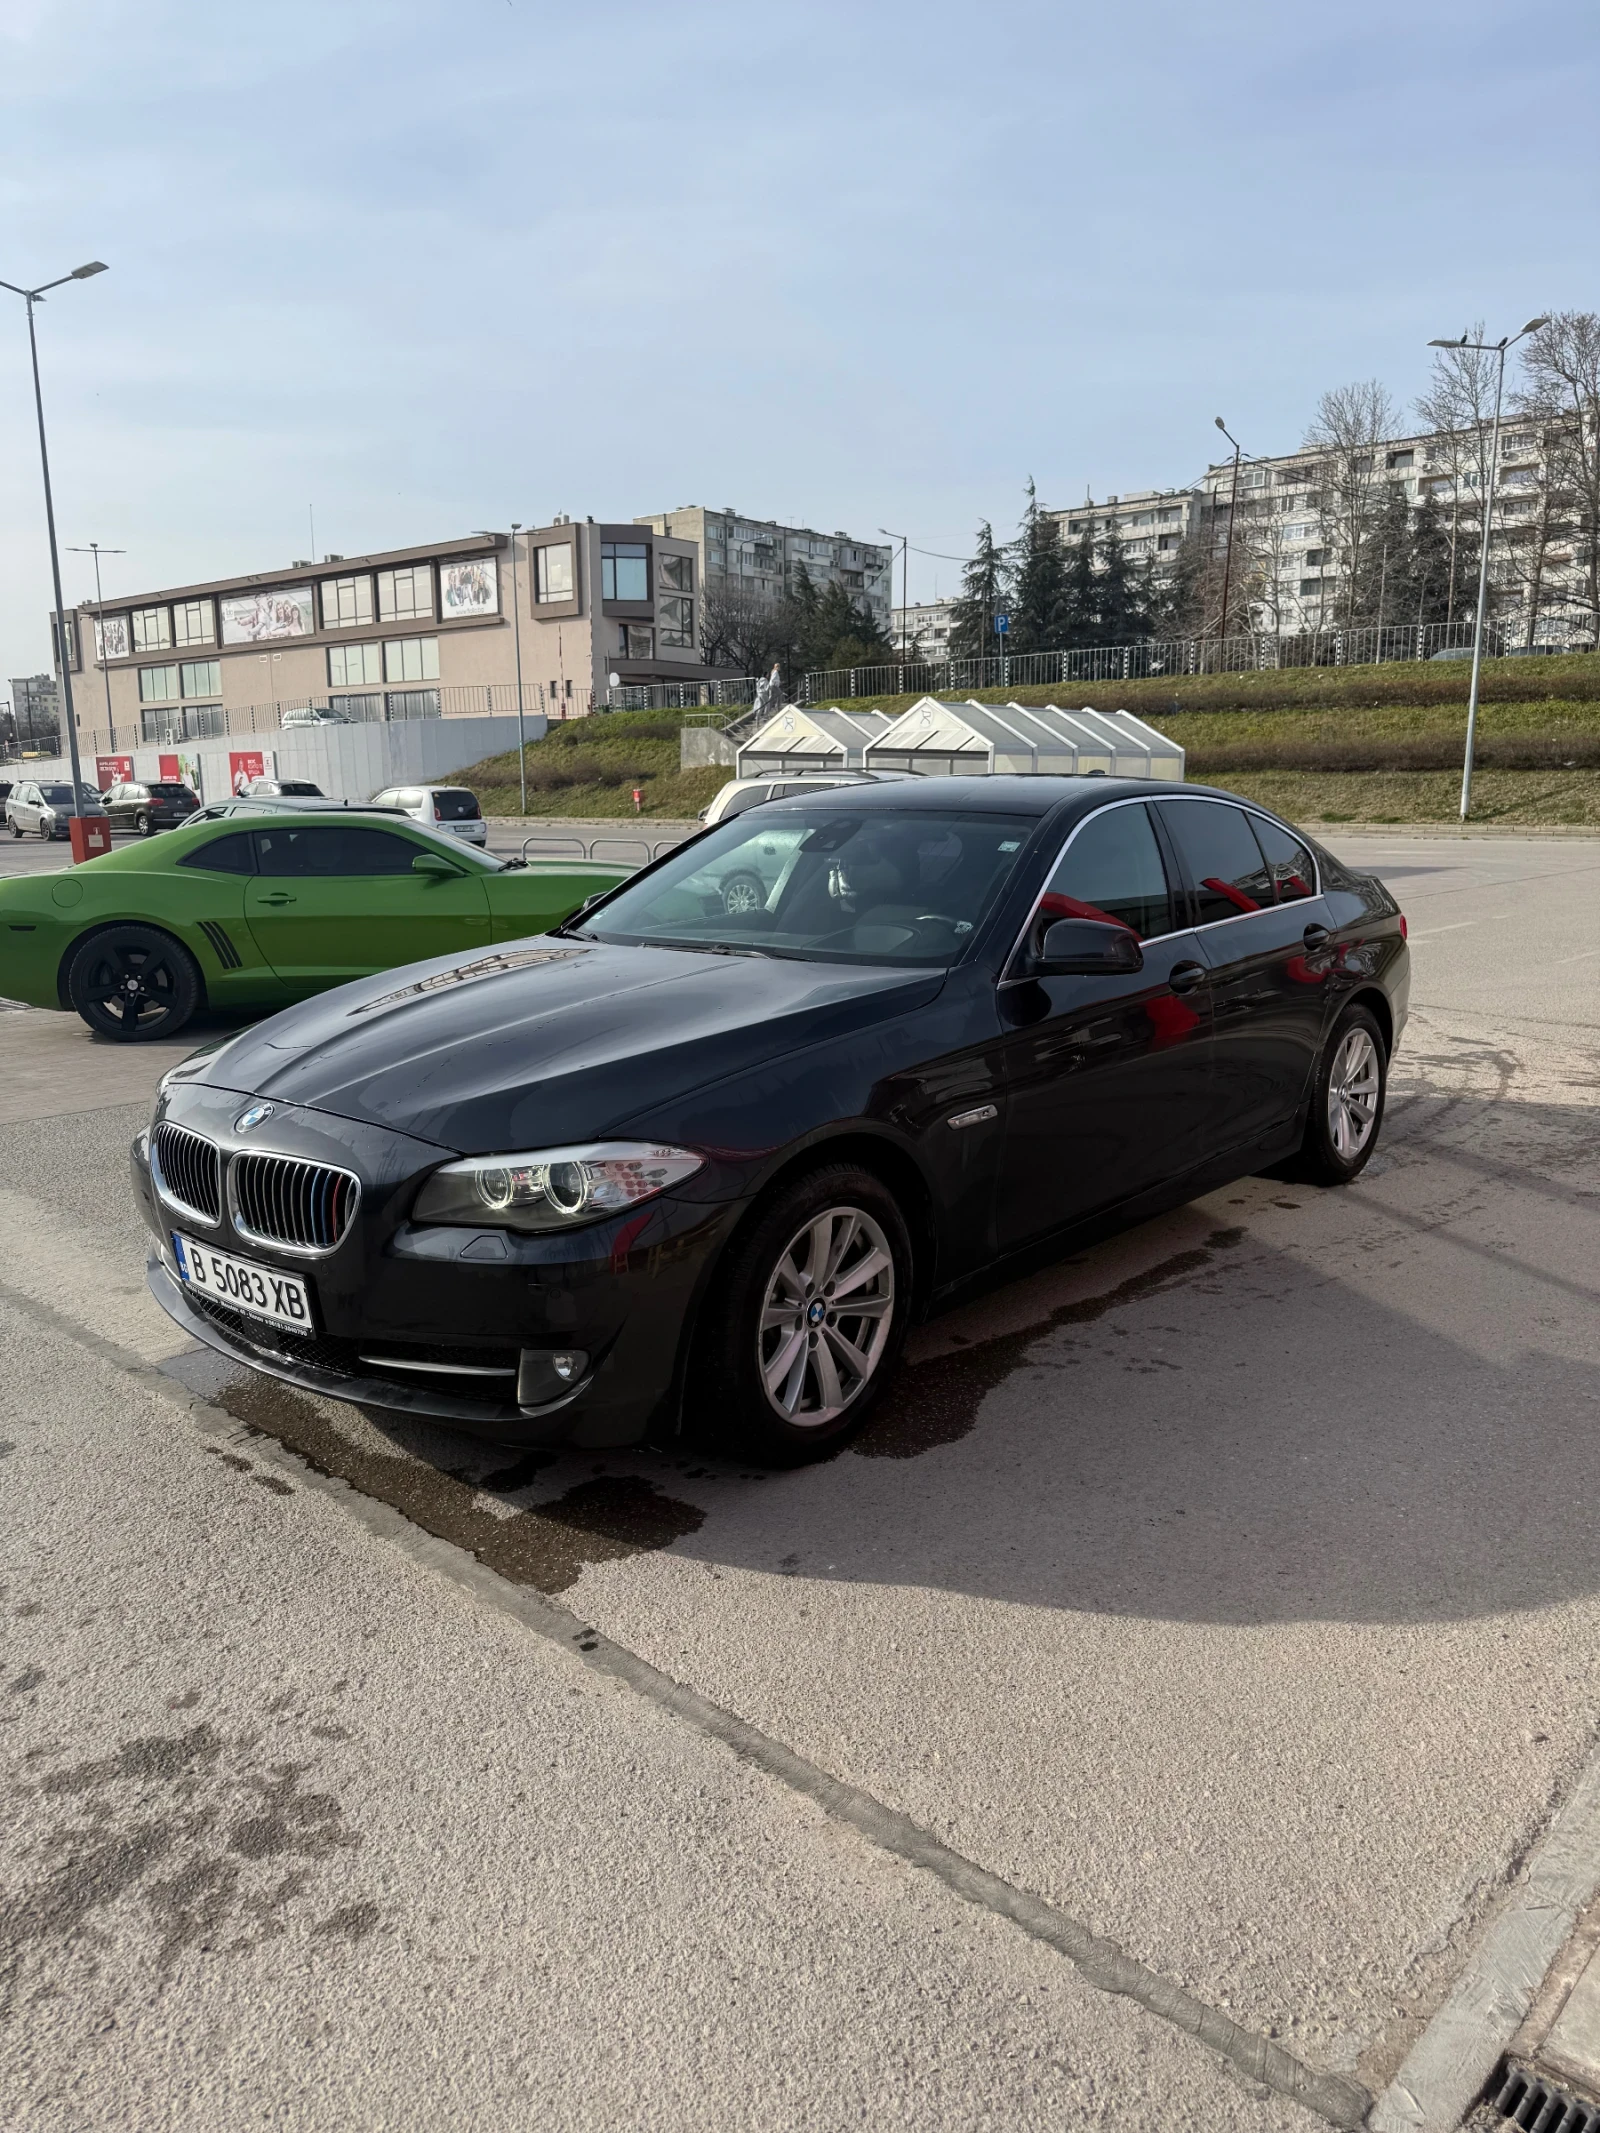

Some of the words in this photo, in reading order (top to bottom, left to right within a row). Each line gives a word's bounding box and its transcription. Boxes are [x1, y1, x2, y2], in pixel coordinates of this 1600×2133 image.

[998, 616, 1006, 631] P
[190, 1247, 206, 1283] B
[211, 1258, 268, 1308] 5083
[269, 1277, 307, 1320] XB
